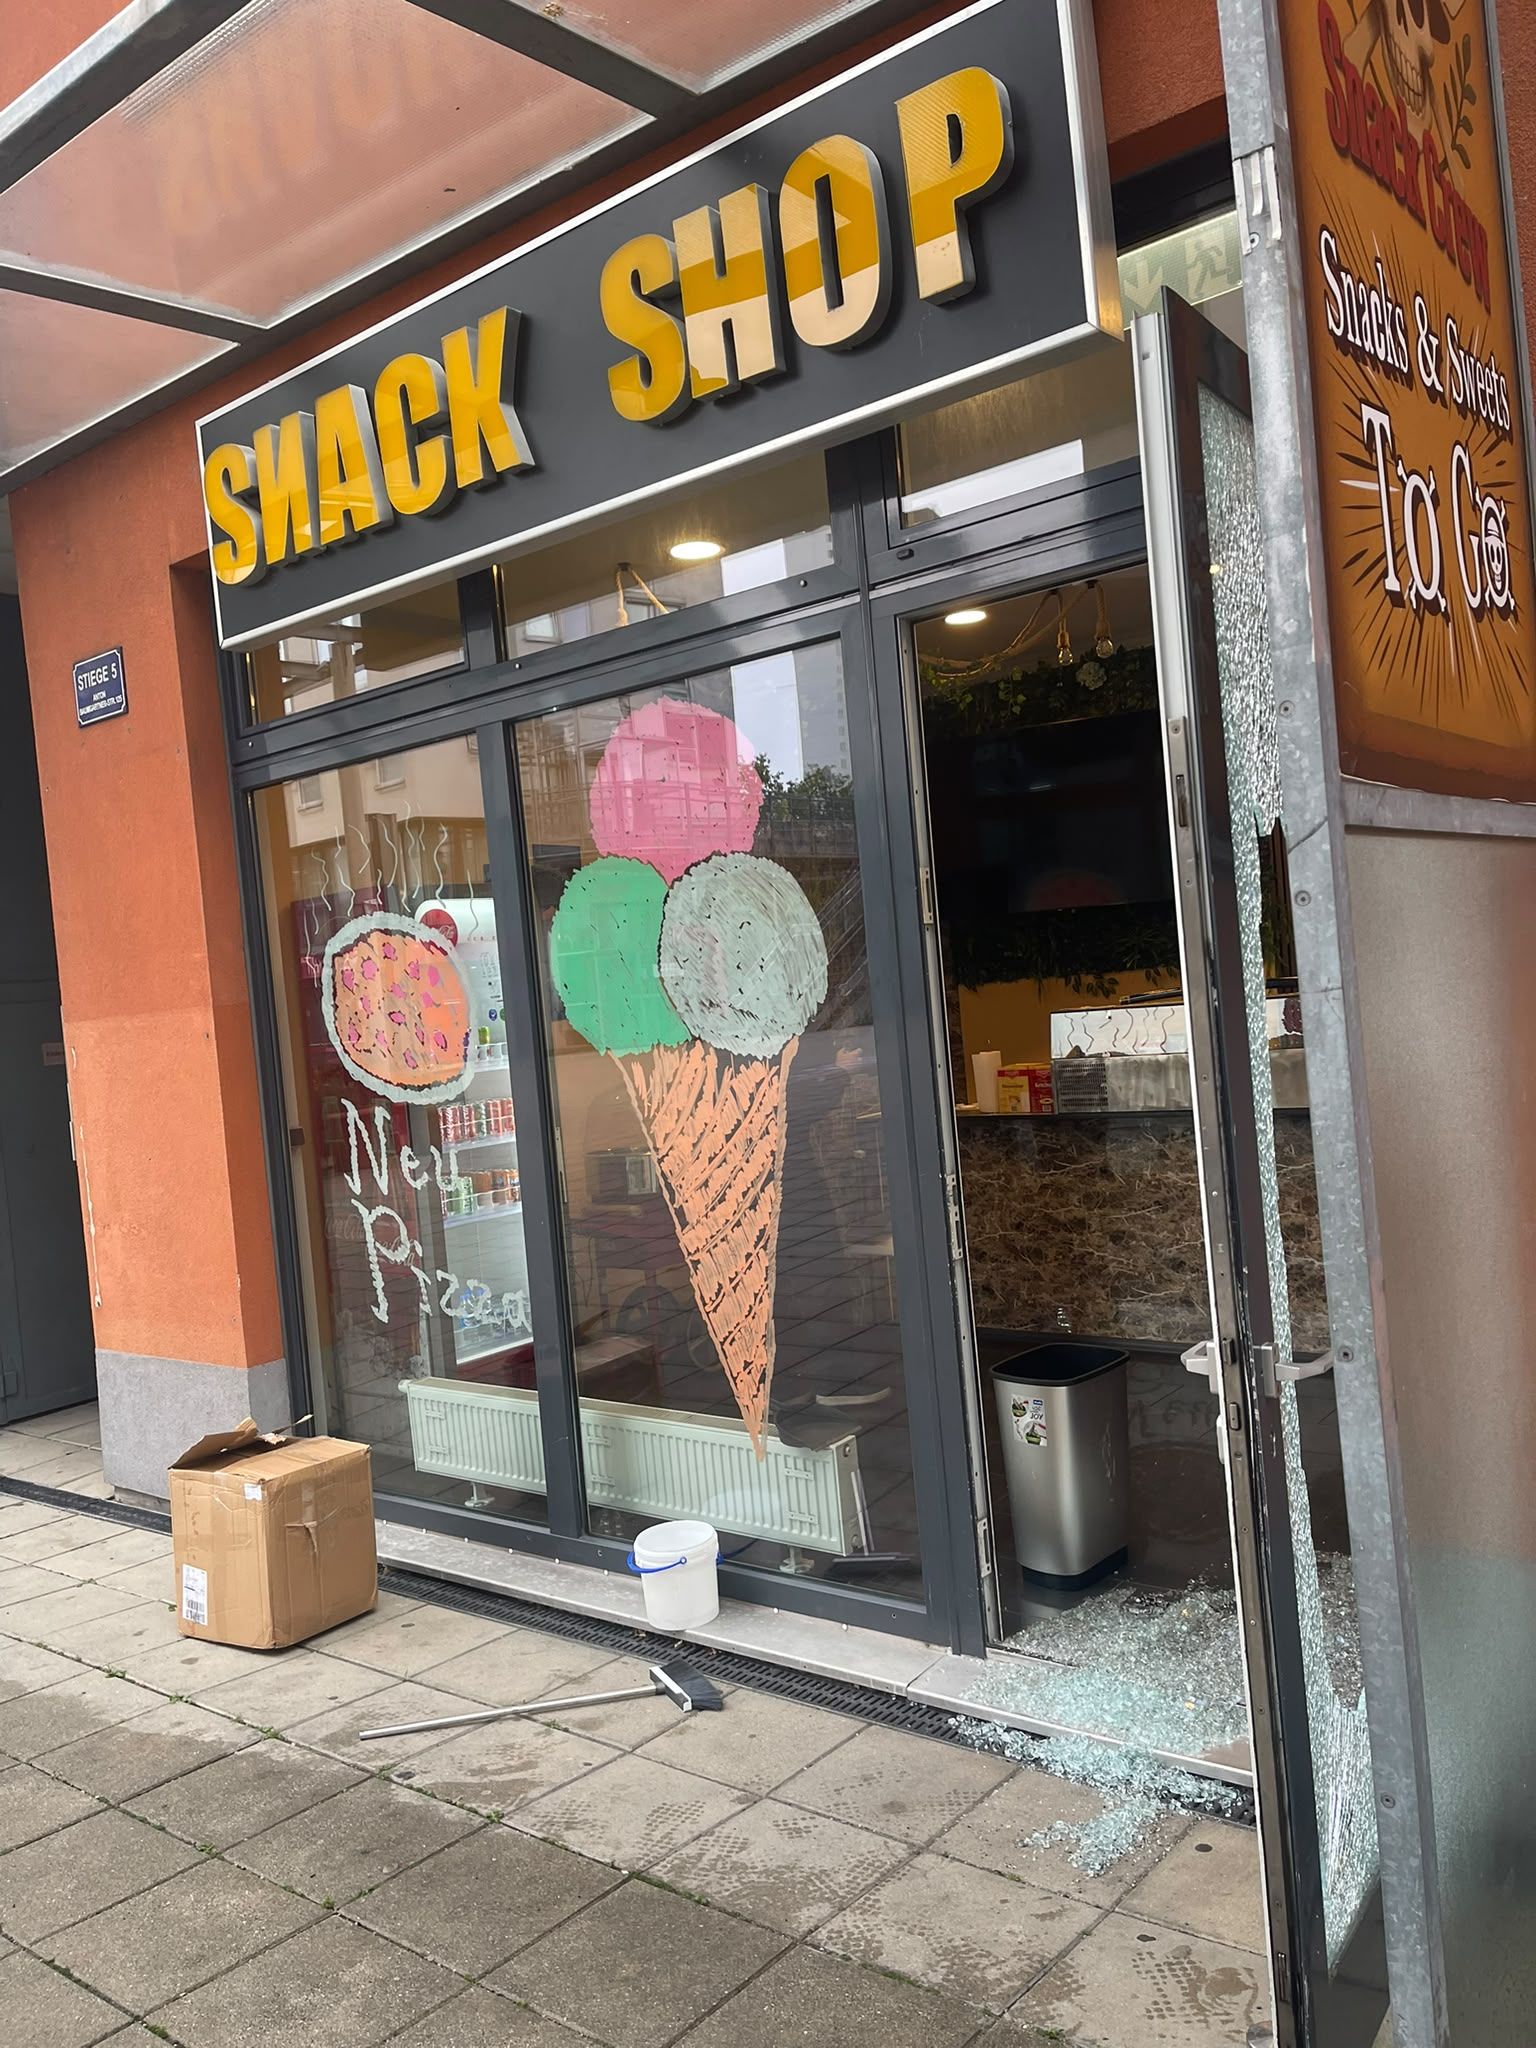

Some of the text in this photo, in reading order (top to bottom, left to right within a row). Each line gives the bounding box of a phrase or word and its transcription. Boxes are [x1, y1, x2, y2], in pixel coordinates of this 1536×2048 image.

[601, 66, 1016, 426] SHOP
[1319, 229, 1511, 431] Snacks & Sweets
[77, 662, 118, 691] STIEGE 5
[341, 1098, 459, 1196] Neu
